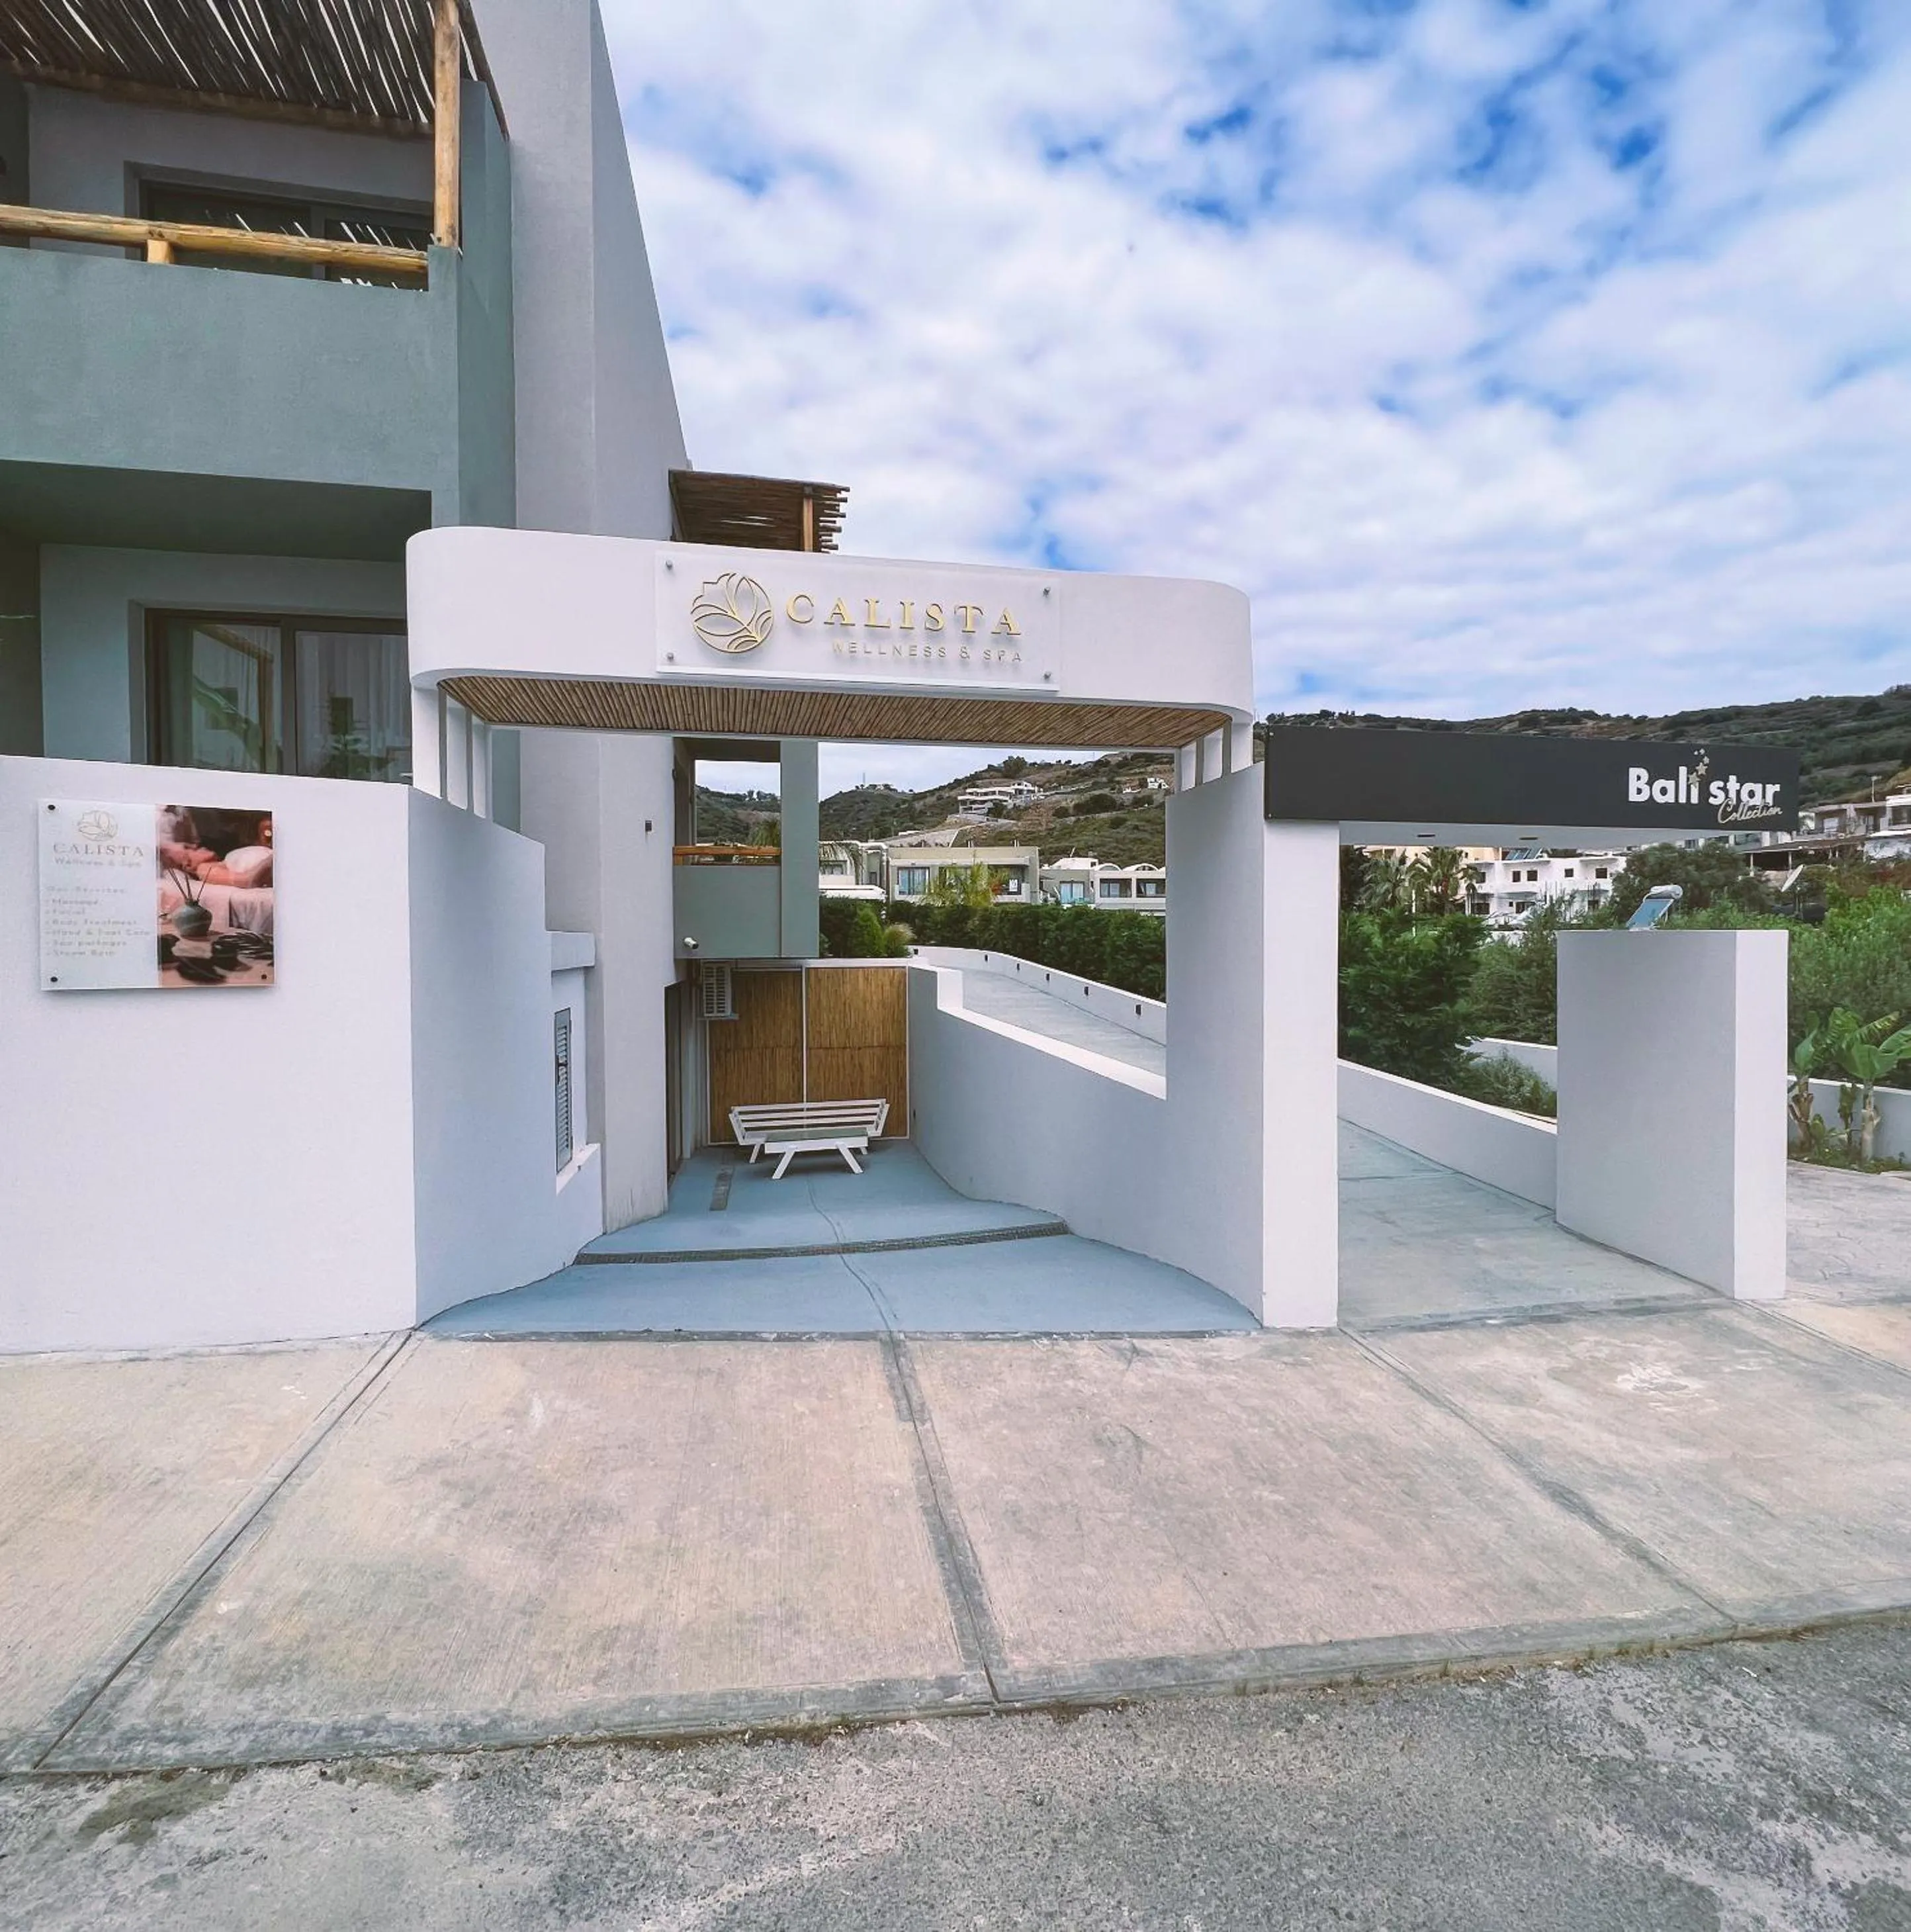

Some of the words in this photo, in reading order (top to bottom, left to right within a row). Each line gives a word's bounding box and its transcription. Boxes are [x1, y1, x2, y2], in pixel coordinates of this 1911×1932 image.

[786, 594, 1021, 635] CALISTA
[832, 639, 947, 657] WELLNESS
[959, 645, 970, 660] &
[983, 649, 1022, 662] SPA
[1628, 766, 1699, 804] Bali
[1709, 774, 1781, 806] star
[1718, 798, 1783, 824] Collection
[53, 843, 144, 857] CALISTA
